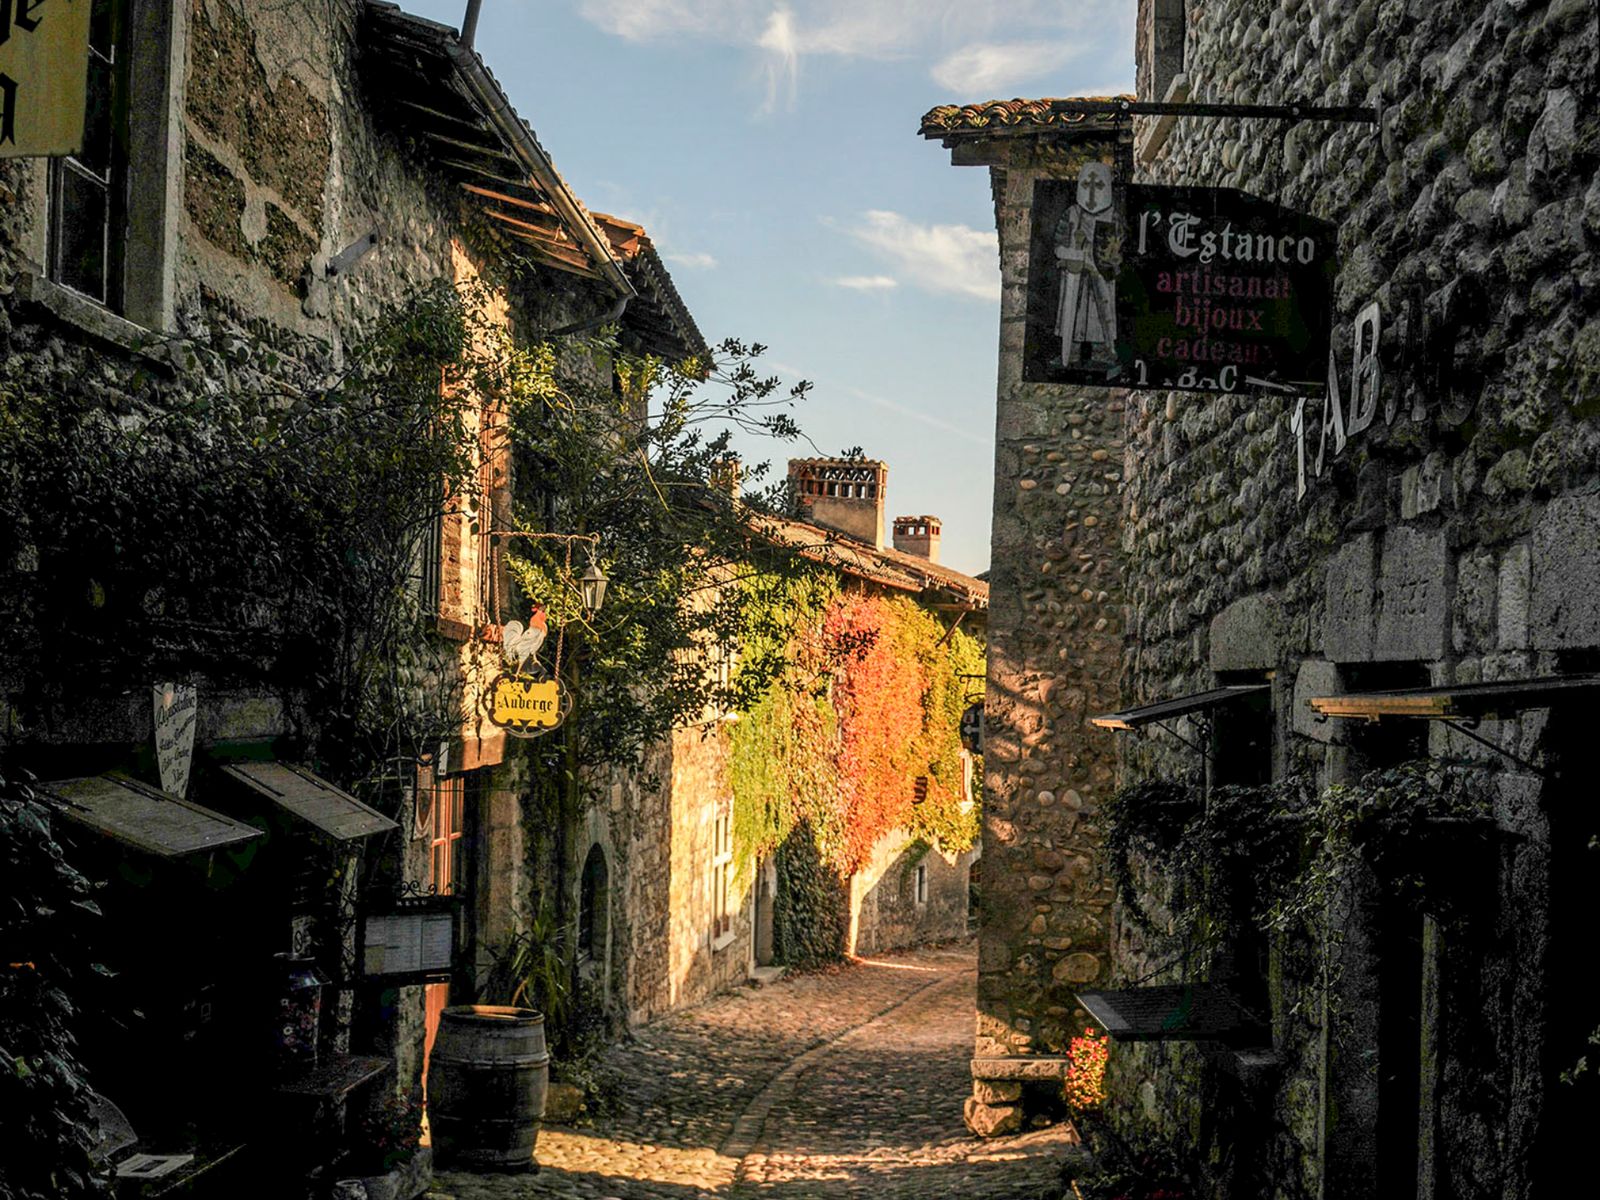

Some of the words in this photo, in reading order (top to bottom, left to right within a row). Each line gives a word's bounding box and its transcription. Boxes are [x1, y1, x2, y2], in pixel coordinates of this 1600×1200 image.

[1137, 210, 1315, 265] l'Estanco
[1174, 296, 1266, 334] bijoux
[498, 694, 553, 713] Auberge
